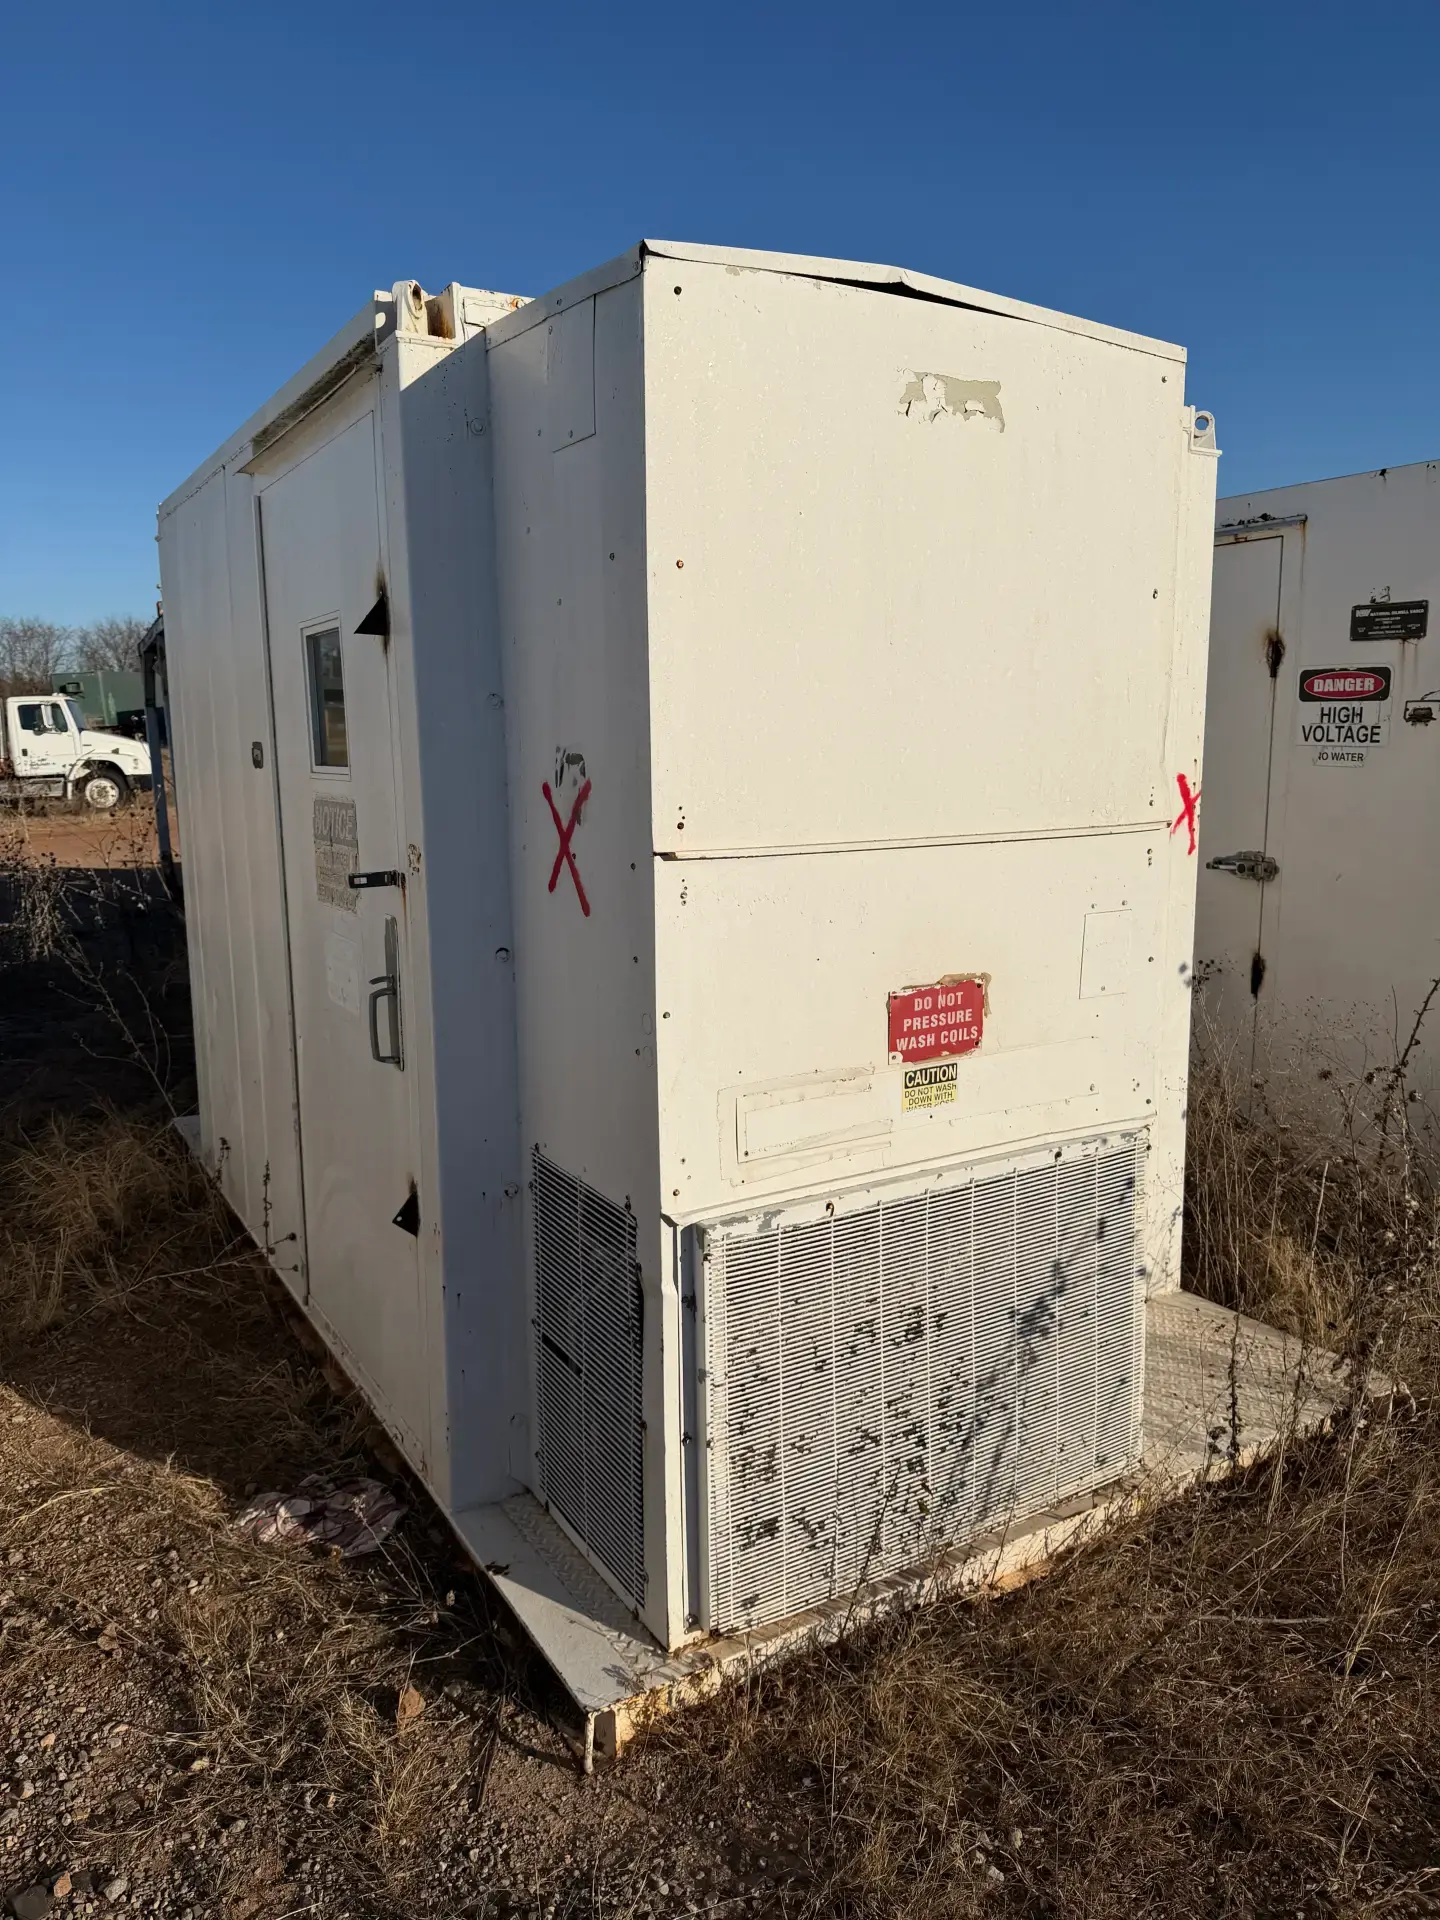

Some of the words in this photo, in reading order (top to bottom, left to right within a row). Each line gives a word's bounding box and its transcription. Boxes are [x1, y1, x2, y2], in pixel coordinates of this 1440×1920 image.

[1313, 677, 1375, 692] DANGER
[1320, 706, 1363, 724] HIGH
[1302, 725, 1381, 743] VOLTAGE
[1331, 752, 1364, 762] WATER
[315, 804, 353, 841] NOTICE
[914, 998, 933, 1011] DO
[938, 991, 964, 1009] NOT
[903, 1009, 973, 1032] PRESSURE
[896, 1034, 935, 1051] WASH
[941, 1026, 978, 1044] COILS
[906, 1065, 957, 1087] CAUTION
[904, 1090, 916, 1099] DO
[917, 1086, 934, 1096] NOT
[935, 1083, 957, 1092] WASH
[908, 1095, 932, 1106] DOWN
[934, 1091, 953, 1101] WITH
